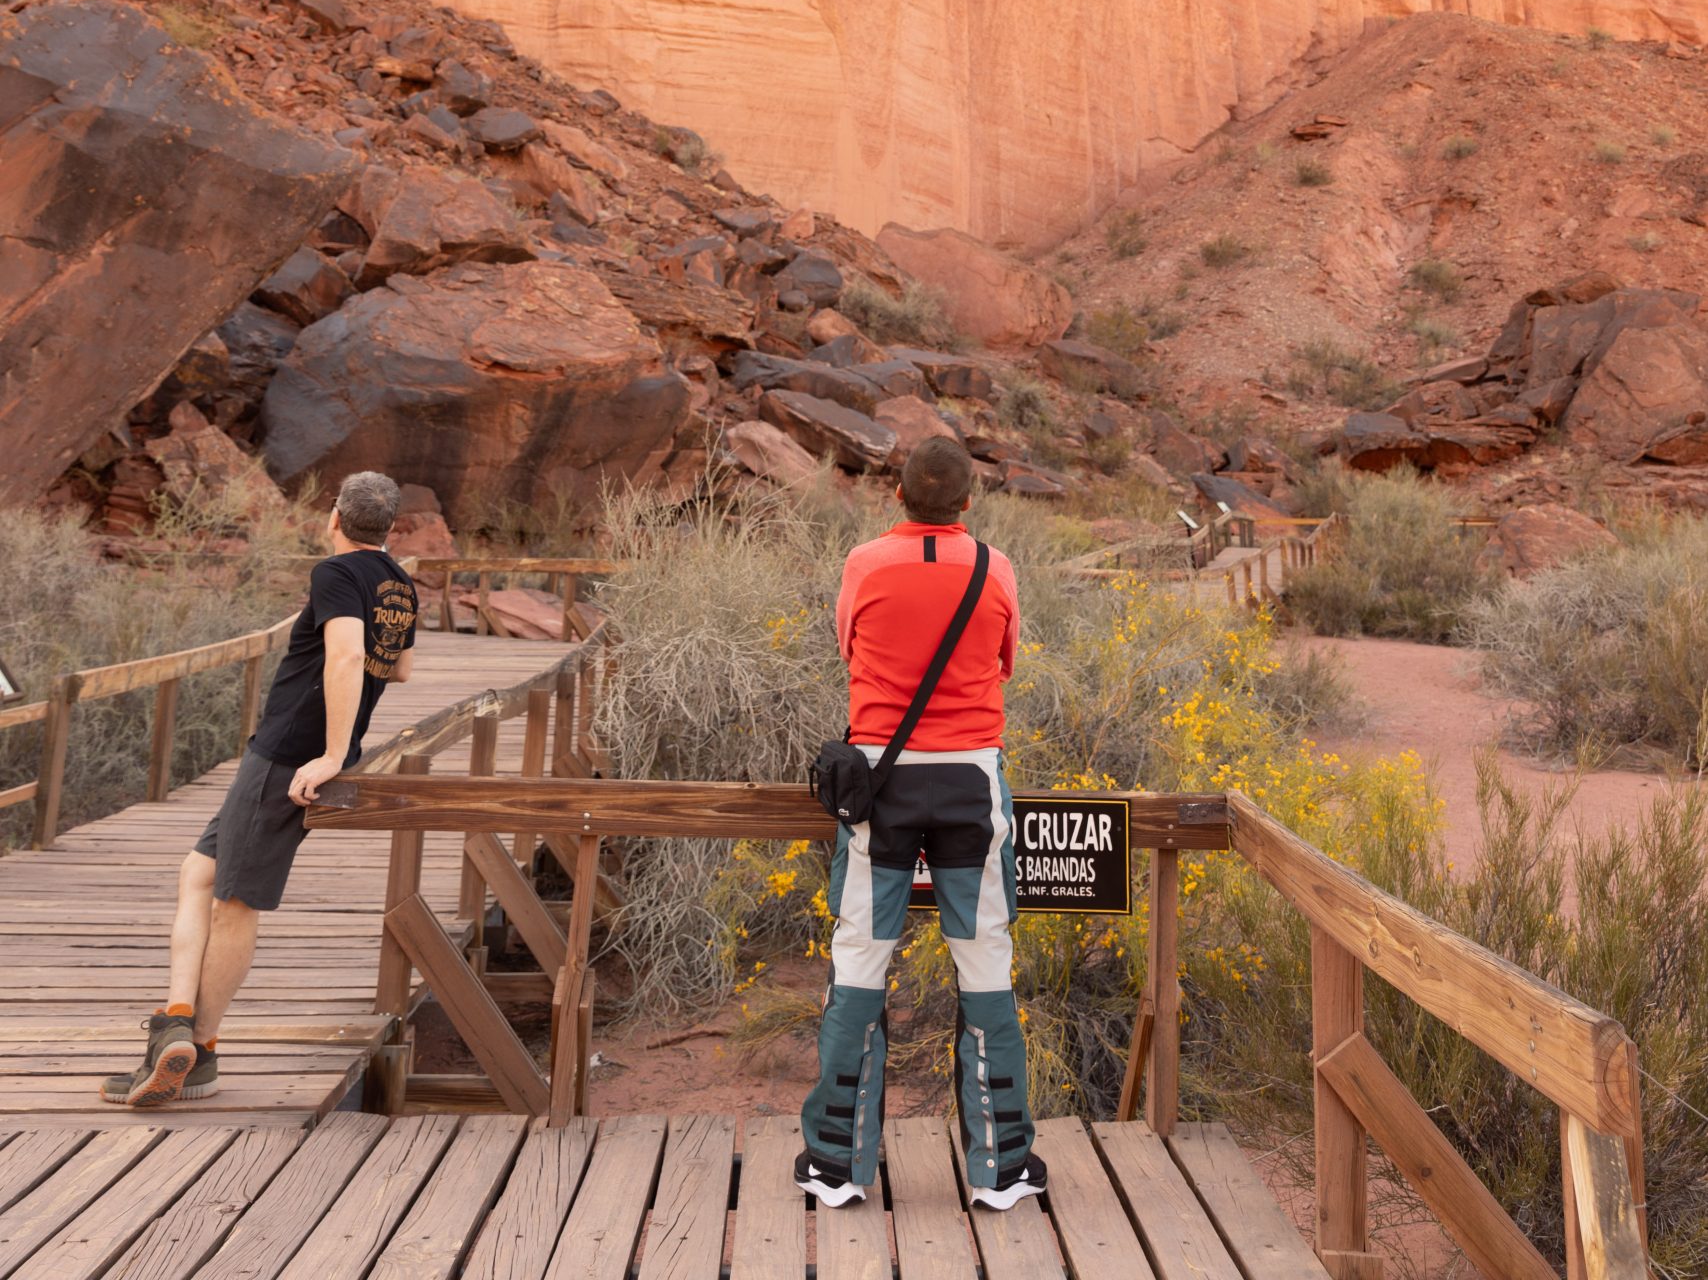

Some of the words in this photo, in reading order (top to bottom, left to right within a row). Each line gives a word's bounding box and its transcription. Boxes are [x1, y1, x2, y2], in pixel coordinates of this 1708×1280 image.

[1023, 811, 1113, 852] CRUZAR
[1026, 856, 1096, 883] BARANDAS
[1028, 886, 1049, 896] INF.
[1051, 887, 1096, 897] GRALES.
